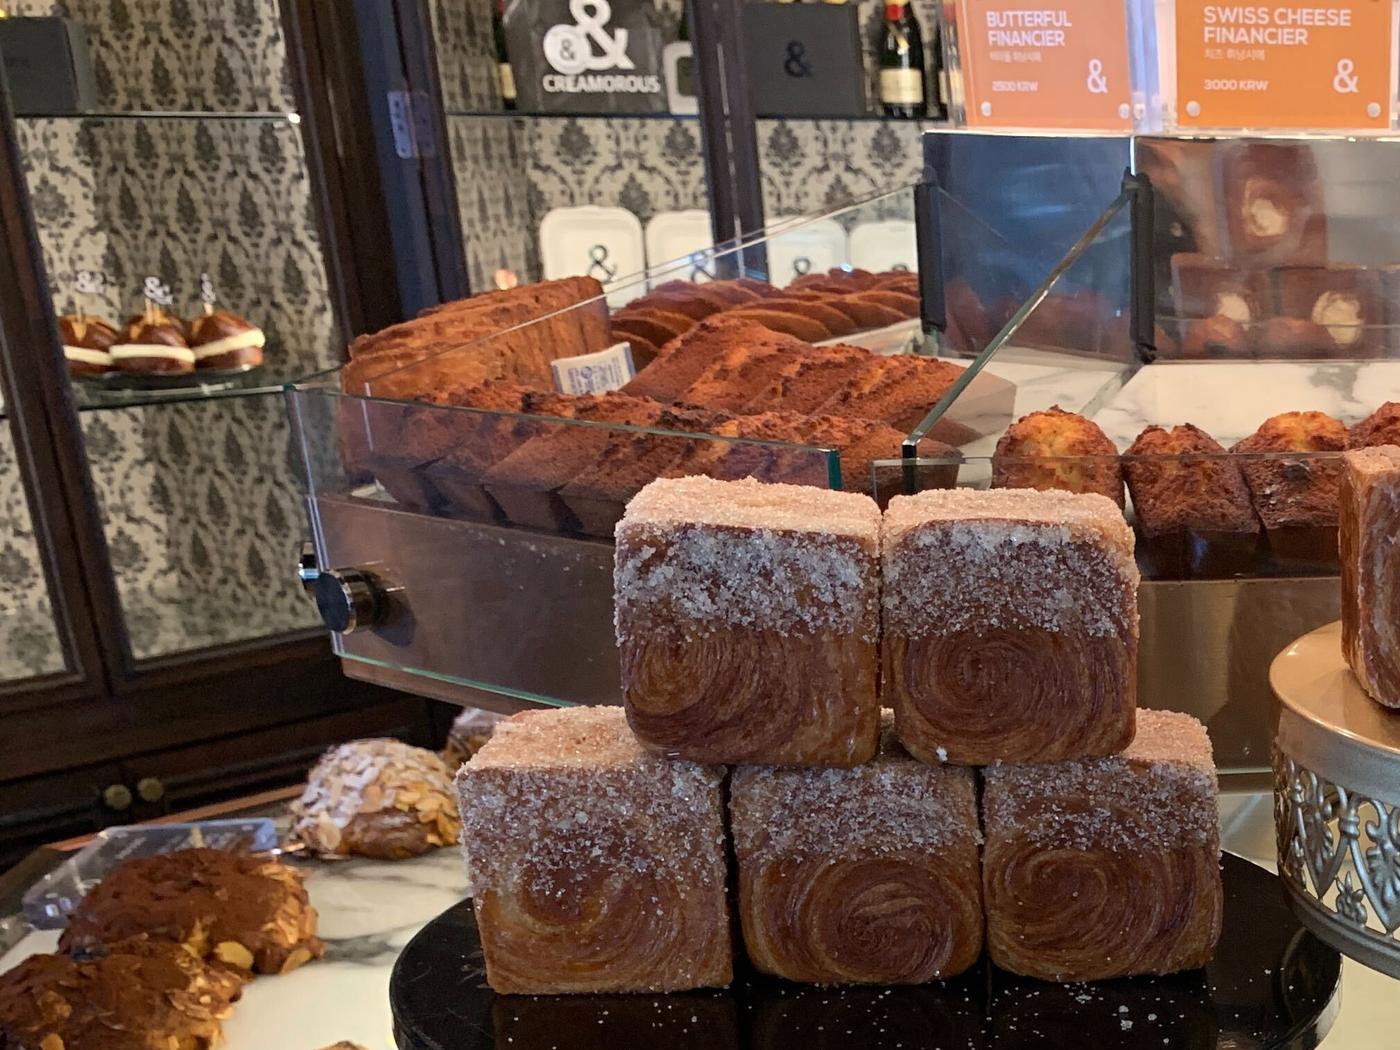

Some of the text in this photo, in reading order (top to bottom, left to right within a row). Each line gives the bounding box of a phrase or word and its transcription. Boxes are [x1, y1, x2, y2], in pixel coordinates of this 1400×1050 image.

[986, 10, 1072, 28] BUTTERFUL
[1203, 6, 1352, 27] SWISS CHEESE
[987, 30, 1065, 47] FINANCIER
[1203, 28, 1309, 45] FINANCIER
[542, 73, 661, 95] CREAMOROUS
[1087, 58, 1108, 94] &
[1204, 80, 1269, 91] 3000 KRW
[1332, 58, 1360, 94] &
